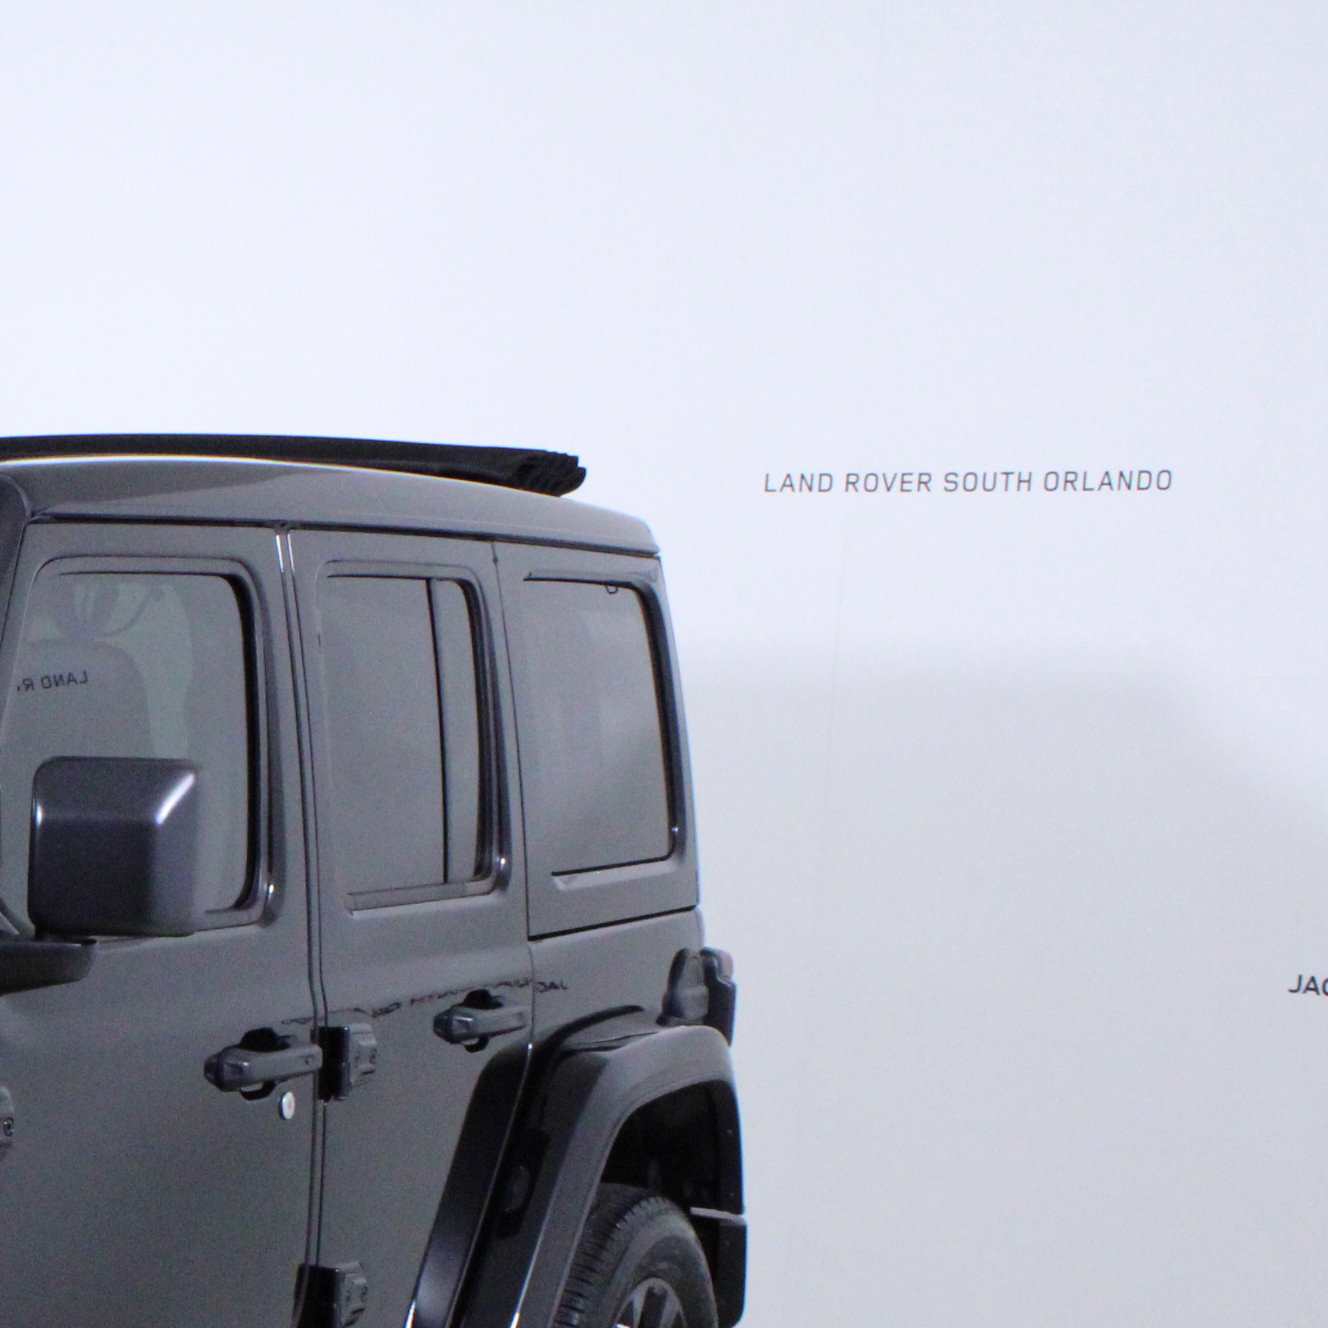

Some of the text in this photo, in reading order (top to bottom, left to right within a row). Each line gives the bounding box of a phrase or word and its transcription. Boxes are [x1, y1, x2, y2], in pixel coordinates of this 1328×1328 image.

[764, 469, 1173, 493] LAND ROVER SOUTH ORLANDO
